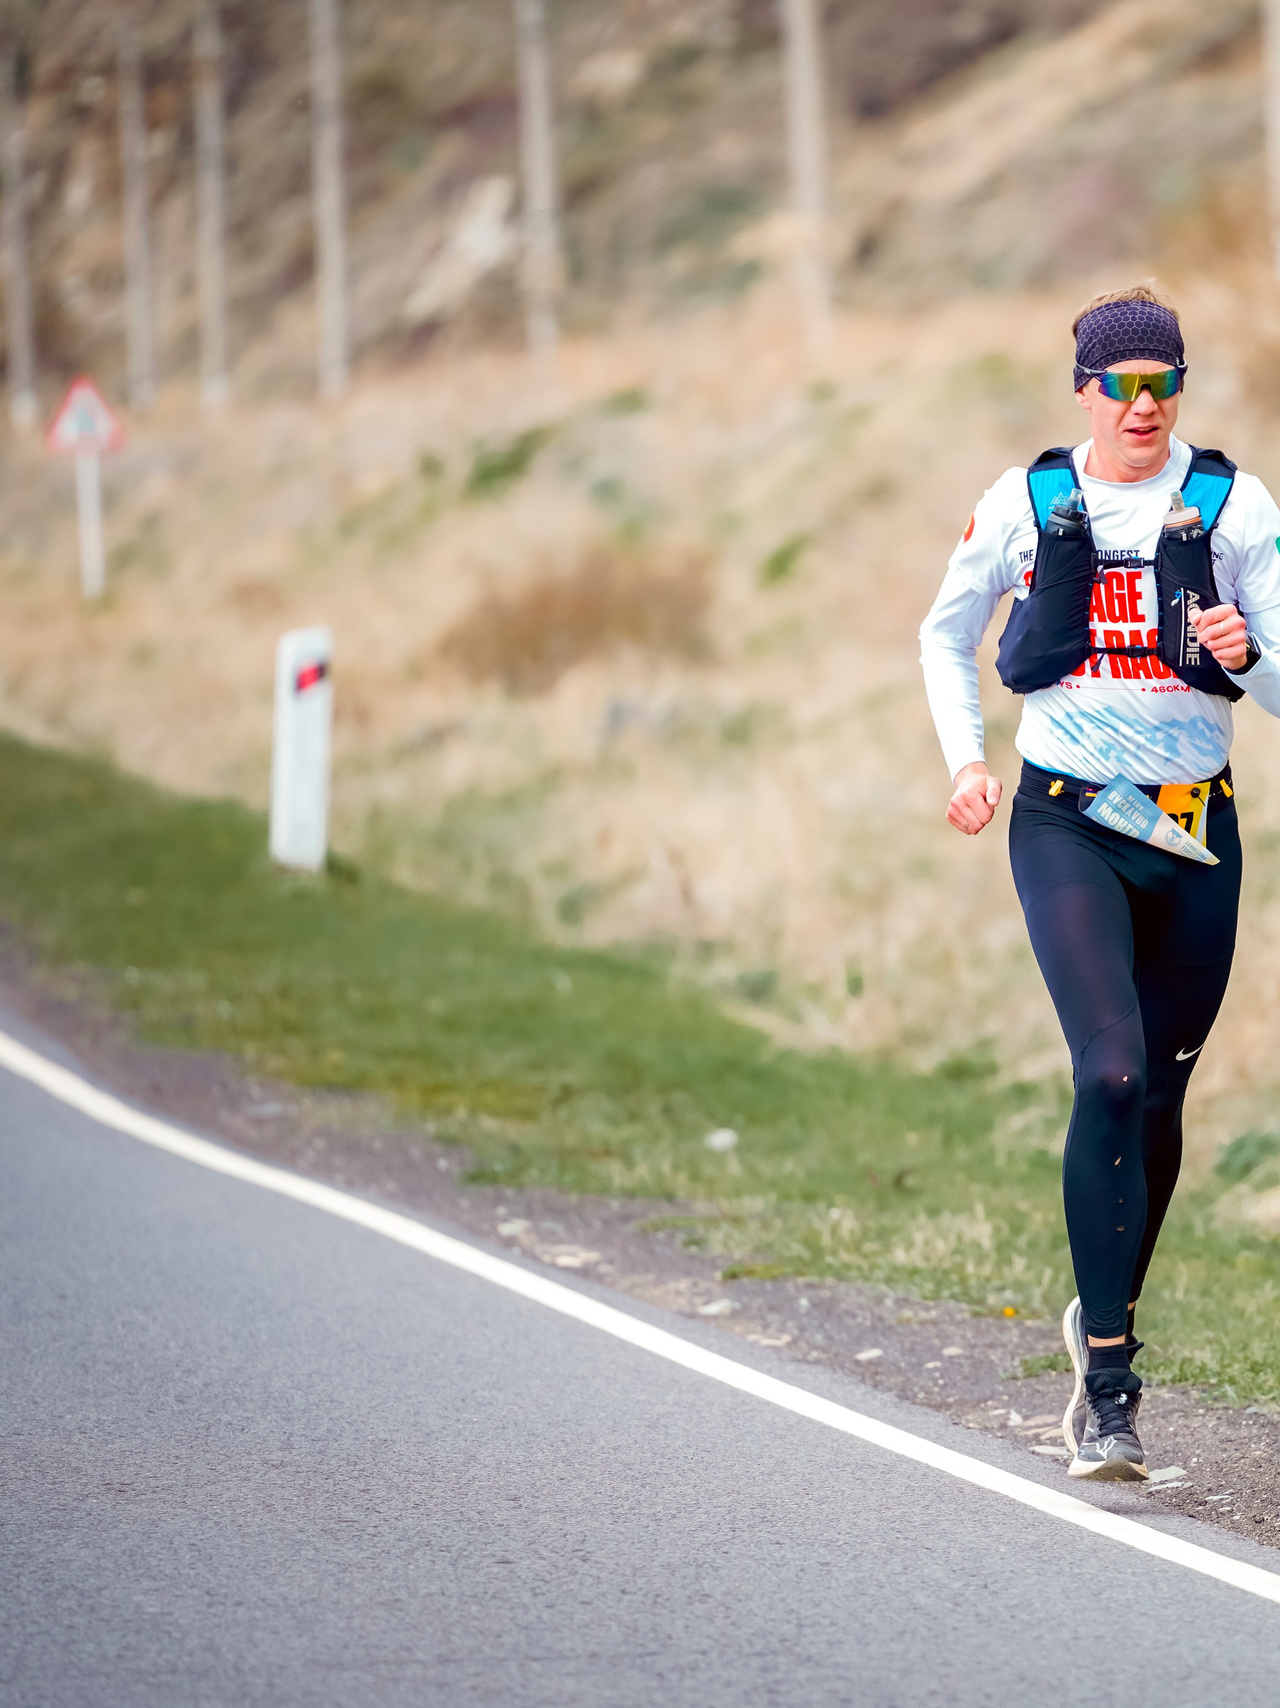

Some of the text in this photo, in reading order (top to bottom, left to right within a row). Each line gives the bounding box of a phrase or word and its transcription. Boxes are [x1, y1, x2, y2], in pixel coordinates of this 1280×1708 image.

[1019, 549, 1034, 563] THE
[1096, 549, 1140, 560] ONGEST
[1089, 571, 1145, 623] AGE
[1103, 628, 1178, 679] RAC
[1059, 681, 1190, 693] YS 460KM
